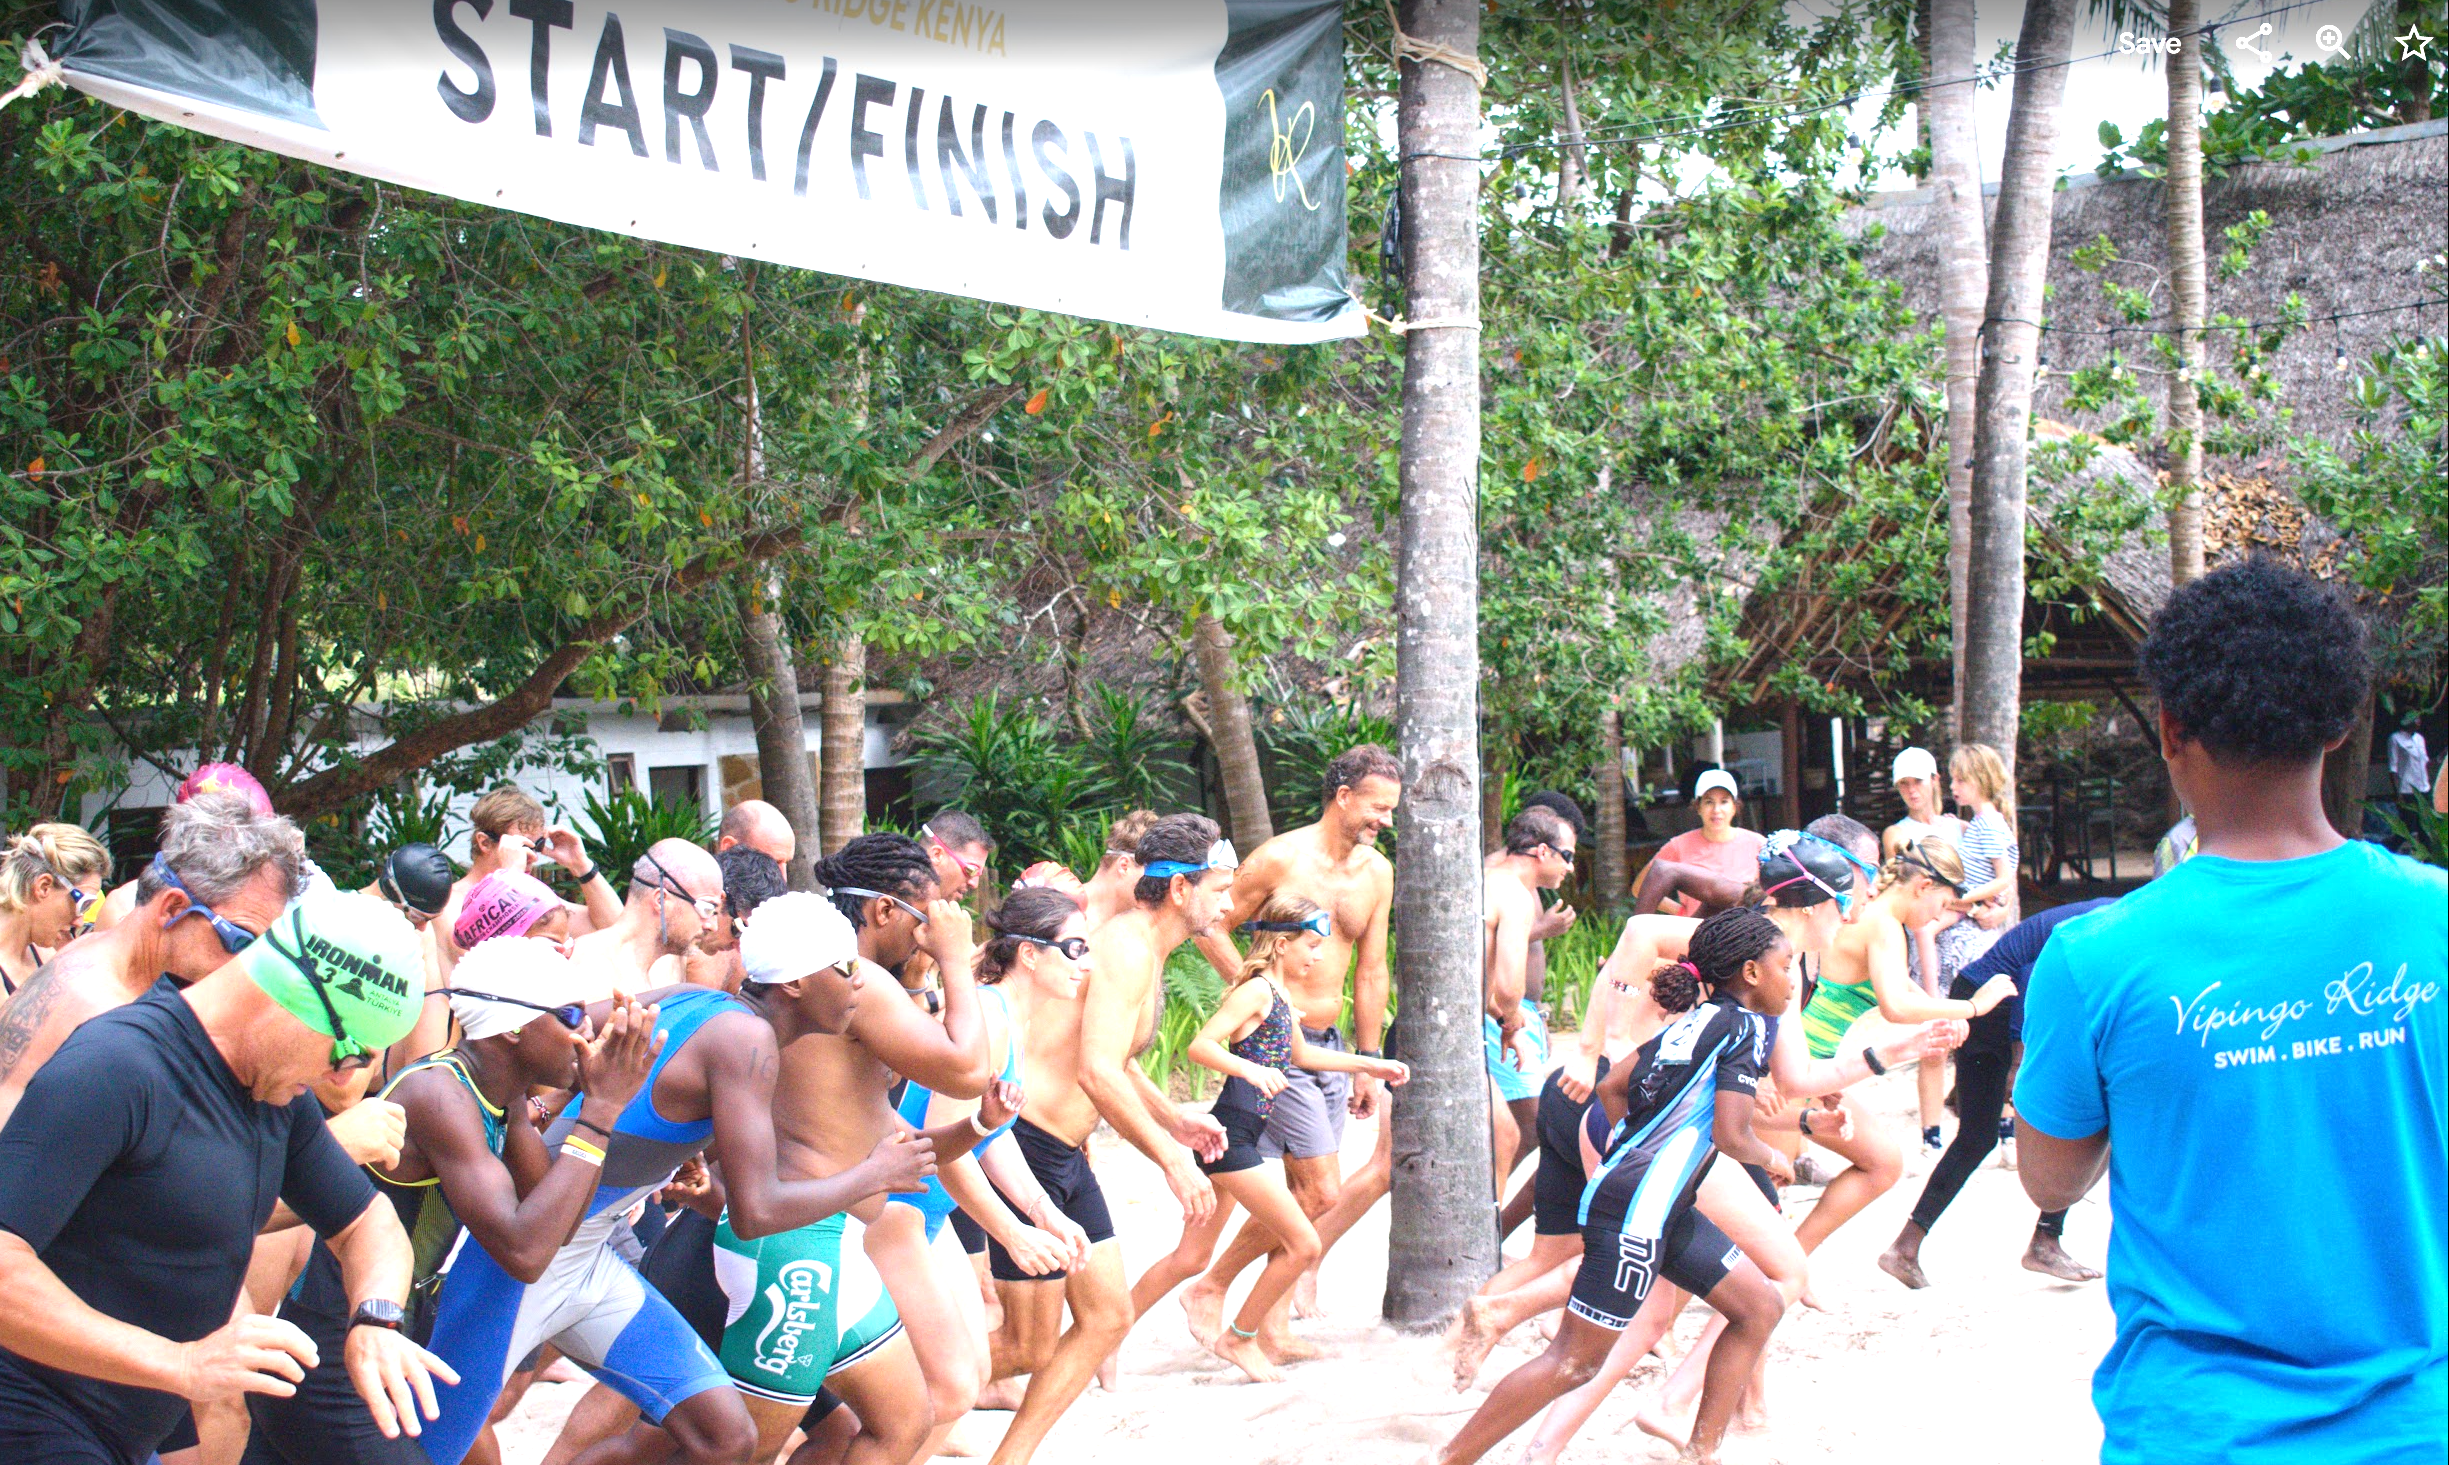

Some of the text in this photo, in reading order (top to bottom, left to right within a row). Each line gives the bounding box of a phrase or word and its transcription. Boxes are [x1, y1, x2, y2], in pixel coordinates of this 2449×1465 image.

[914, 0, 1007, 58] KENYA
[463, 887, 521, 943] AFRICAN
[306, 933, 408, 998] IRONMAN
[2169, 961, 2440, 1048] Vipingo Ridge
[2214, 1045, 2276, 1069] SWIM
[2292, 1036, 2342, 1060] BIKE
[2358, 1026, 2405, 1049] RUN
[754, 1259, 832, 1376] Carlsberg
